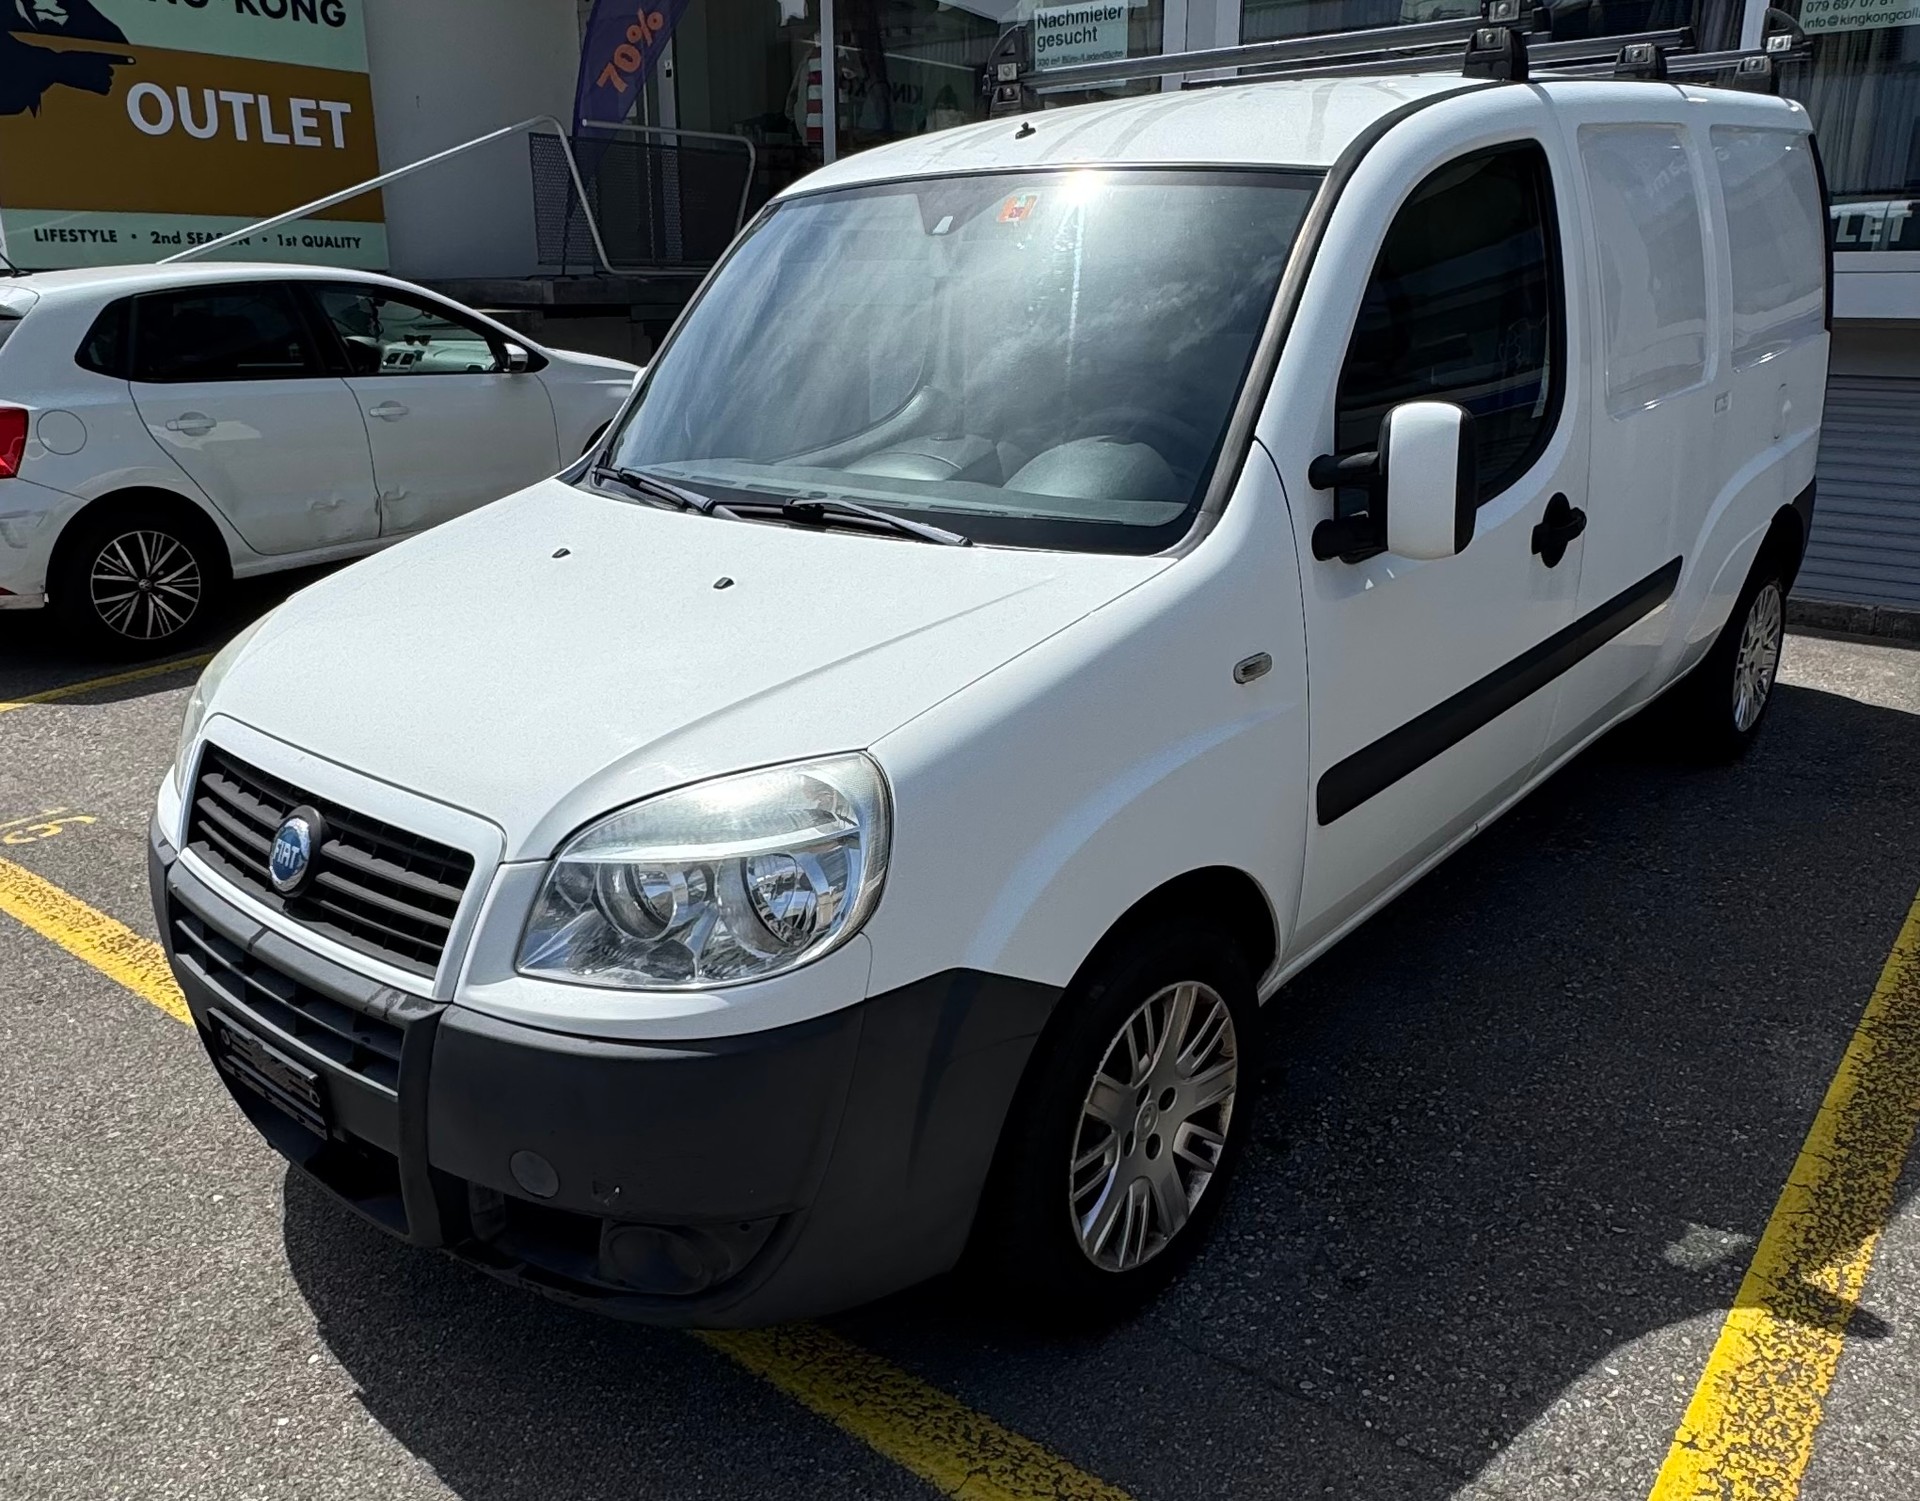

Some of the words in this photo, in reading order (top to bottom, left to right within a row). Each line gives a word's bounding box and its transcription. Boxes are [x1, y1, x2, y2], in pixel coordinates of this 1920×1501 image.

[1037, 6, 1124, 29] Nachmieter
[596, 7, 664, 93] 70%
[1037, 26, 1098, 52] gesucht
[126, 82, 352, 149] OUTLET
[34, 228, 117, 243] LIFESTYLE
[150, 231, 181, 245] 2nd
[277, 234, 297, 247] 1st
[302, 235, 361, 249] QUALITY
[273, 838, 300, 869] FIAT
